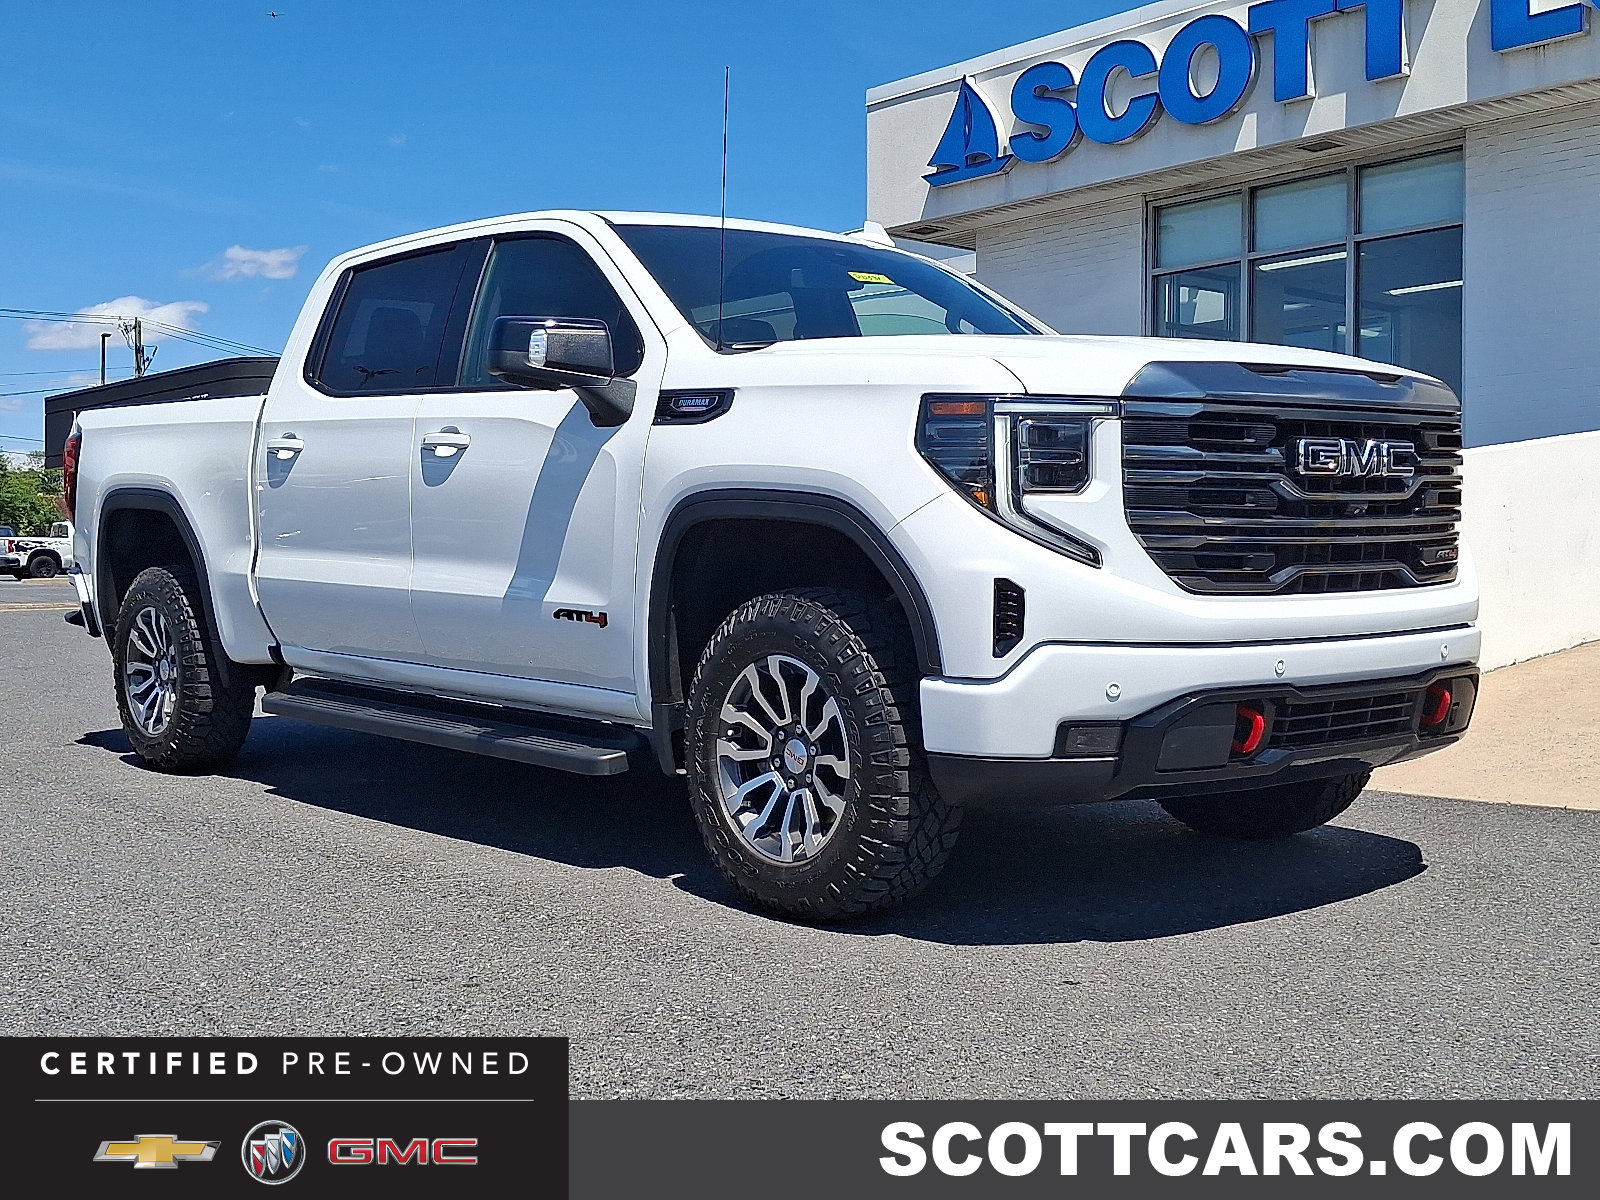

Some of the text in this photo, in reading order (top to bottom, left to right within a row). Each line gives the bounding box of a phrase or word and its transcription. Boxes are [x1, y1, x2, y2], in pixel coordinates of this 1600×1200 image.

[1010, 0, 1402, 162] SCOTT
[678, 398, 710, 407] DURAMAX
[1298, 438, 1415, 477] GMC
[553, 607, 608, 628] AT4
